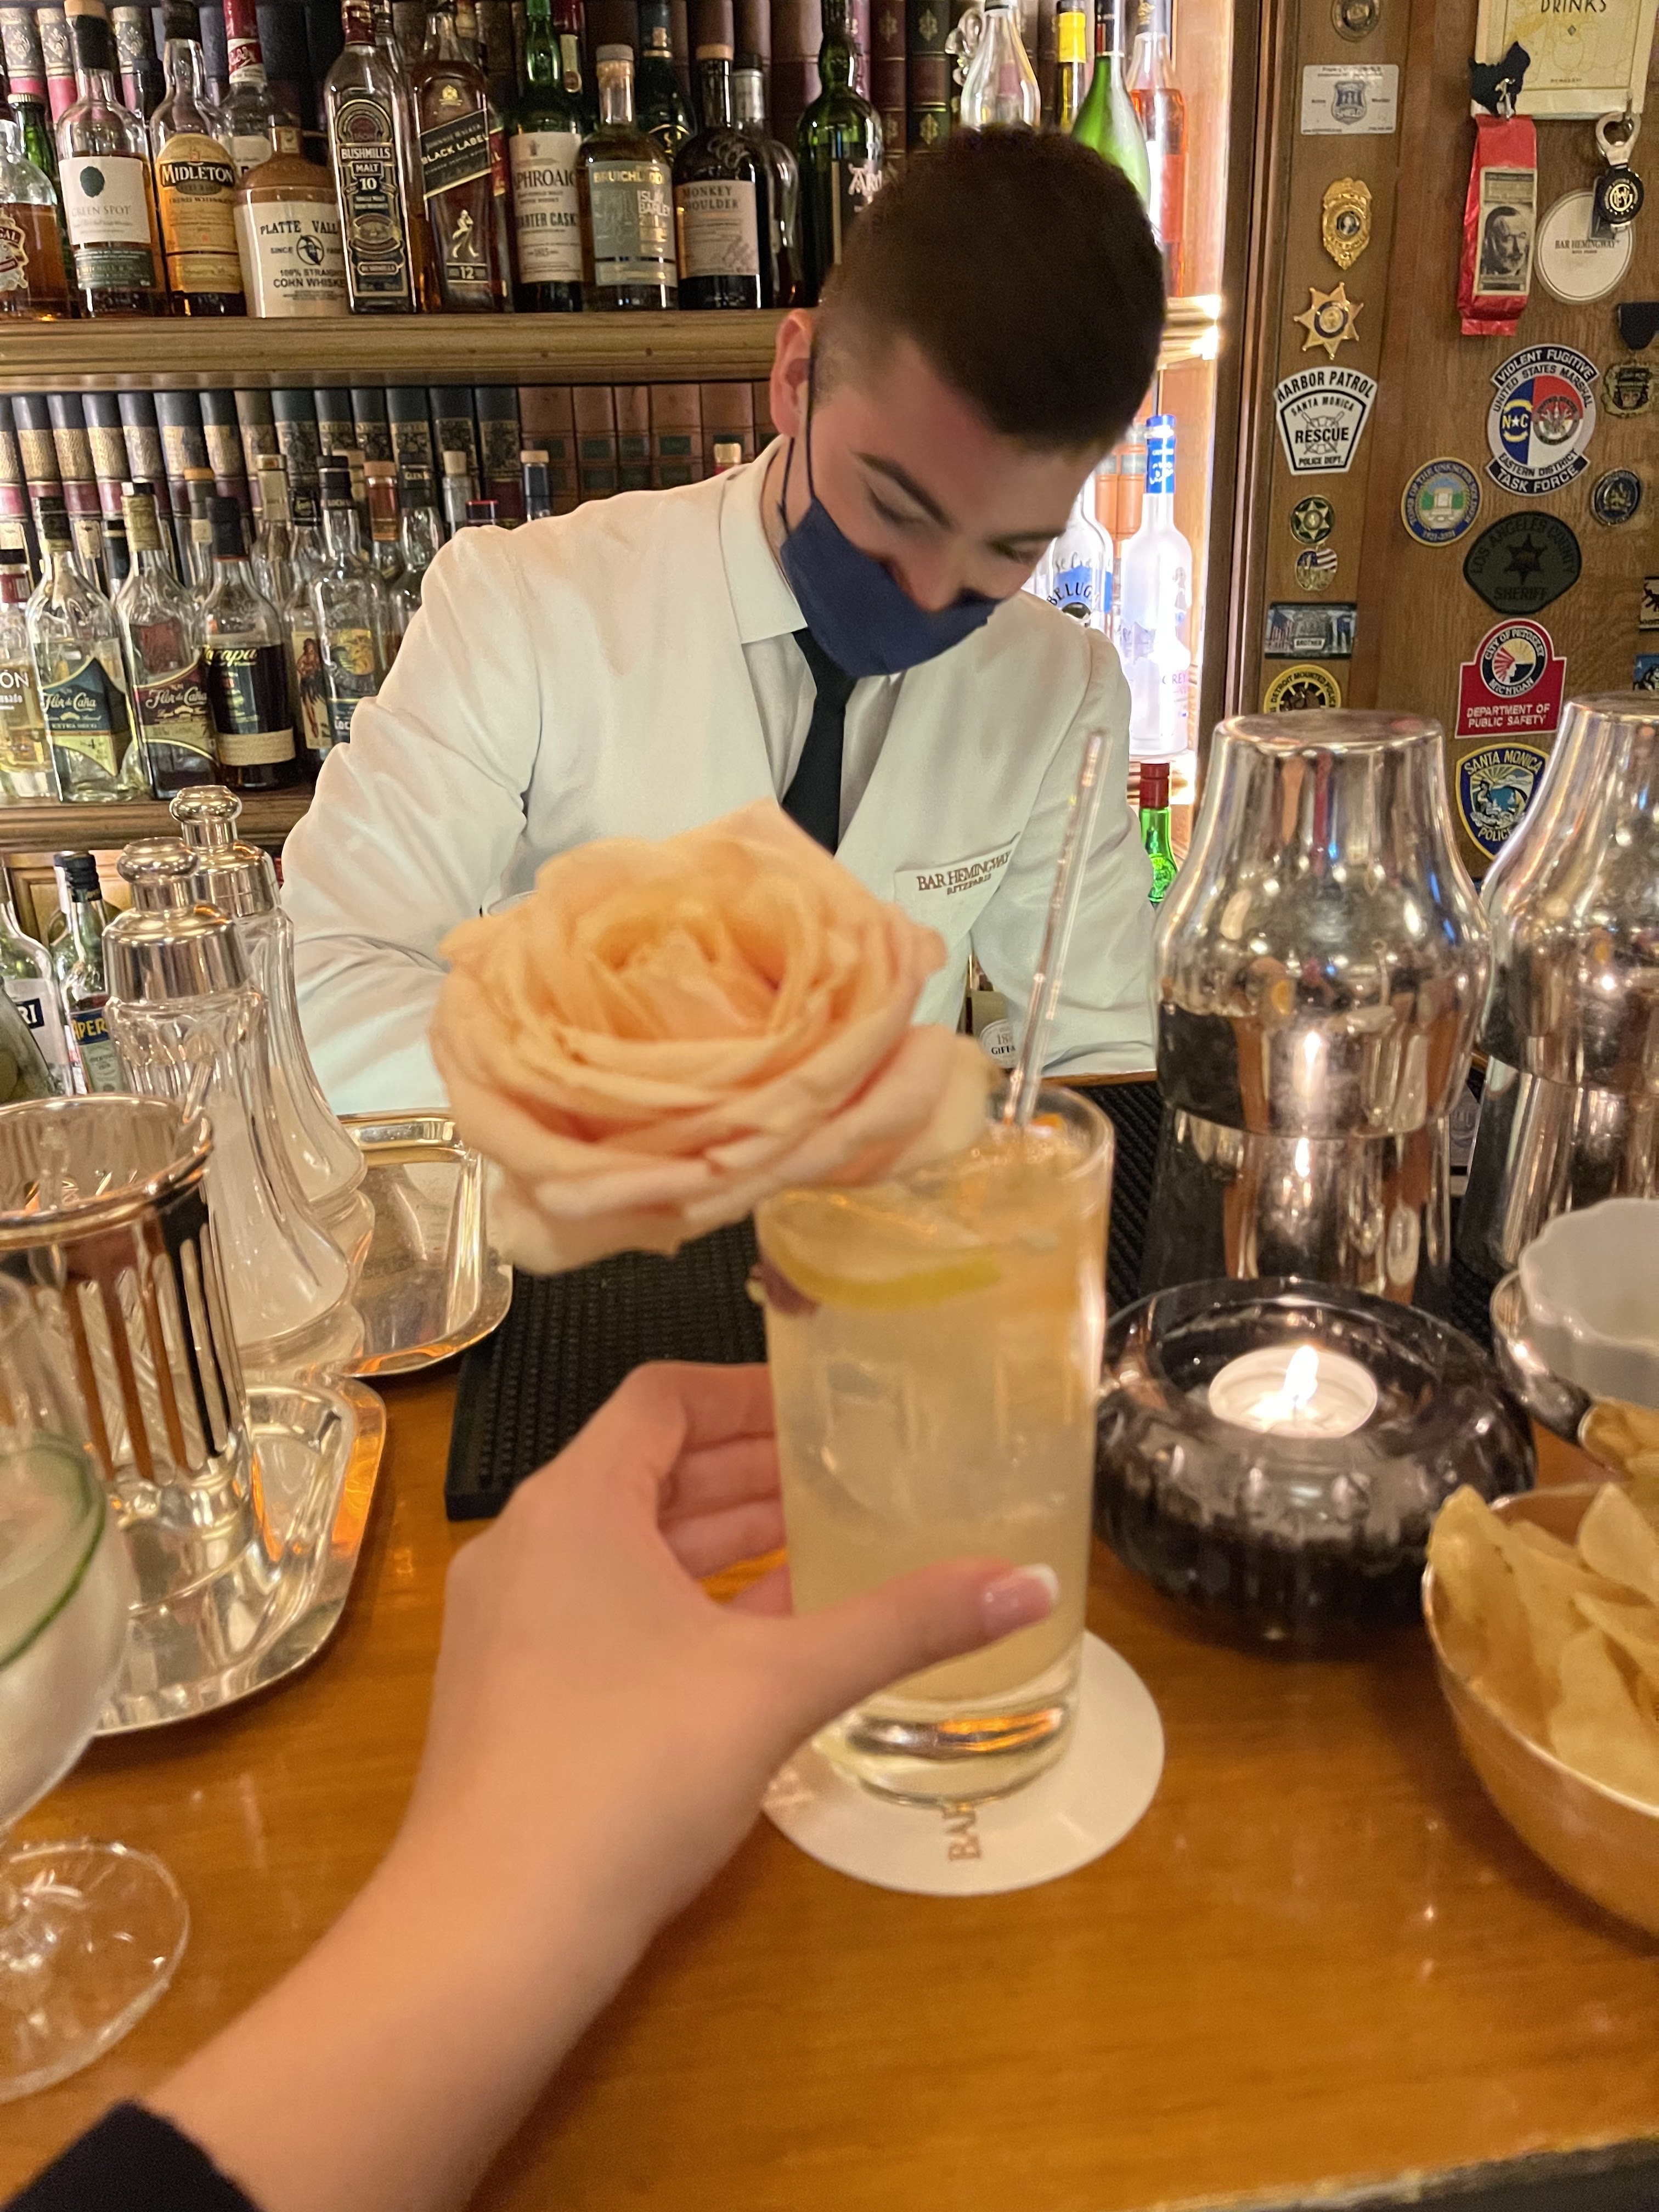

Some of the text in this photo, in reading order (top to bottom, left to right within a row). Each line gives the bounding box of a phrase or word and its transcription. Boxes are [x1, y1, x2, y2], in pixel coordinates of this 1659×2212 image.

[341, 148, 391, 159] BUSHMILLS
[421, 145, 455, 165] BLACK
[456, 134, 489, 151] LABEL
[162, 164, 234, 184] MIDLETON
[356, 164, 379, 172] MALT
[359, 177, 377, 190] 10
[514, 169, 577, 190] PHROAI
[683, 185, 732, 197] MONKEY
[72, 205, 132, 217] GREEN SPOT
[684, 199, 739, 211] HOULDER
[260, 221, 302, 235] PLATTE
[550, 212, 577, 227] CASK
[1555, 240, 1570, 249] BAR
[460, 266, 475, 280] 12
[273, 278, 303, 288] CORN
[1497, 348, 1594, 382] VIOLENT FUGITIVE
[1277, 371, 1374, 403] HARBOR PATROL
[1493, 364, 1593, 413] UNITED STATES MARSHAL
[1290, 396, 1355, 417] SANTA MONICA
[1502, 413, 1529, 429] N C
[1295, 427, 1349, 444] RESCUE
[1299, 456, 1323, 466] POLICE
[1498, 448, 1579, 477] EASTERN DISTRICT
[1497, 465, 1578, 493] TASK FORCE
[1047, 582, 1097, 606] BELUG
[1493, 586, 1549, 600] SHERIFF
[1485, 629, 1545, 661] CITY OF PETOSKEY
[1271, 674, 1293, 703] DETROIT
[1293, 672, 1327, 684] MOUNTED
[1488, 676, 1535, 695] MICHIGAN
[145, 689, 175, 709] Flor
[1466, 703, 1551, 718] DEPARTMENT OF
[1468, 714, 1547, 729] PUBLIC SAFETY
[1464, 749, 1543, 775] SANTA MONICA
[916, 851, 1012, 891] BAR HEMINGWAY
